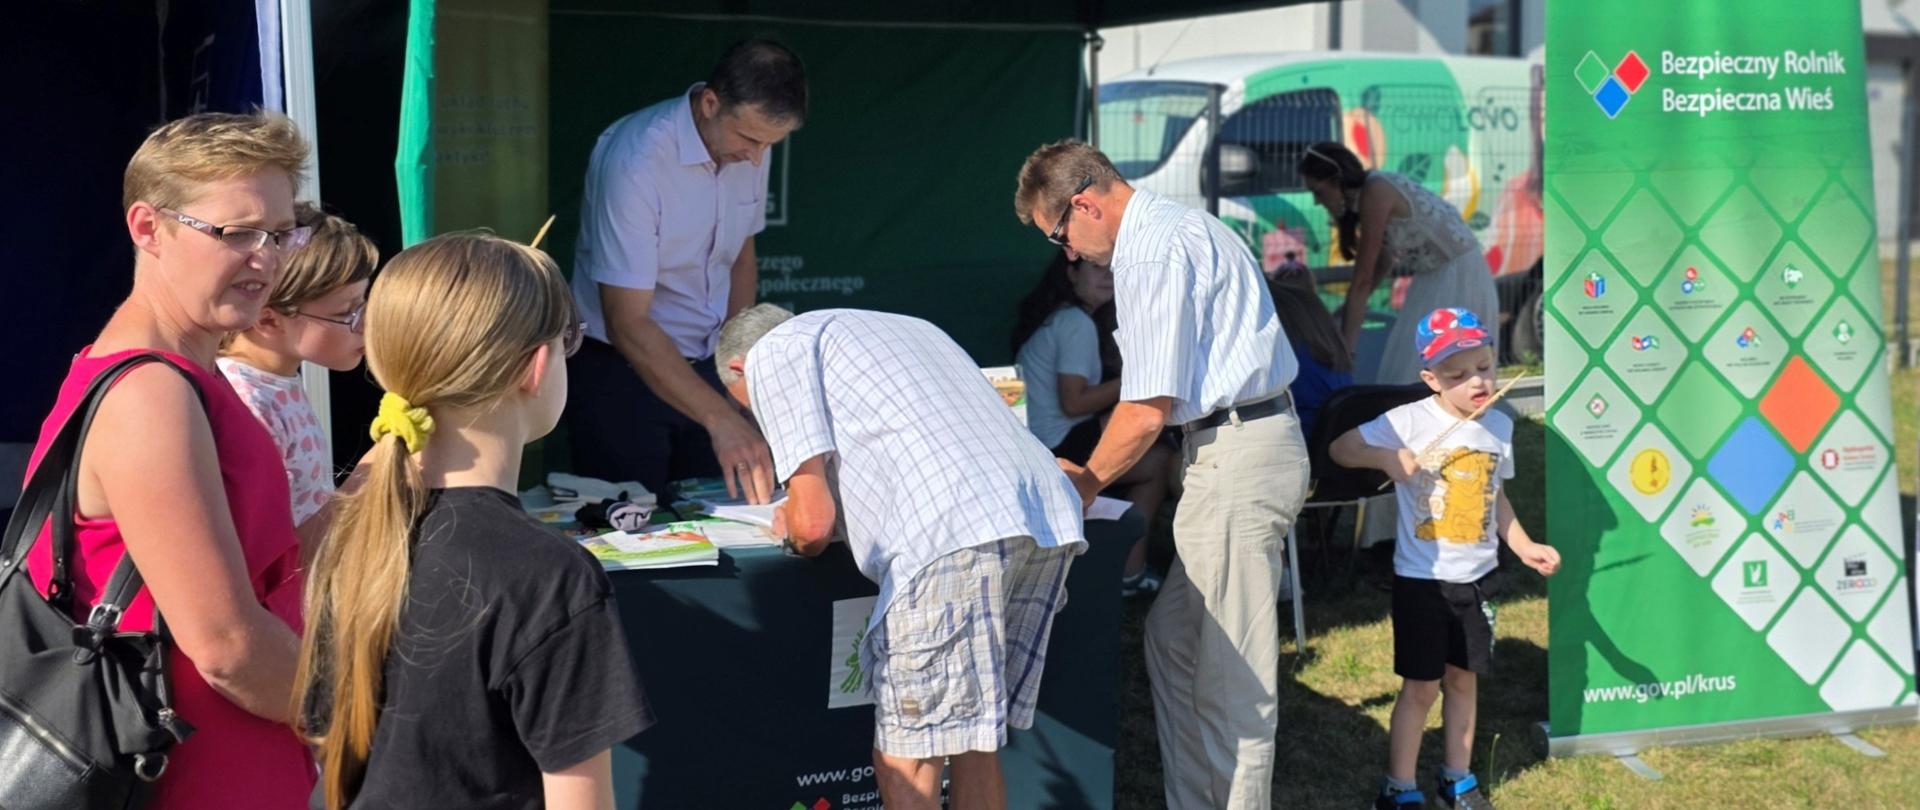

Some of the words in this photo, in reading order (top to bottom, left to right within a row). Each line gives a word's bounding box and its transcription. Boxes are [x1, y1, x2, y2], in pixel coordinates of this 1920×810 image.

[1661, 51, 1778, 79] Bezpieczny
[1786, 50, 1846, 74] Rolnik
[1661, 88, 1781, 116] Bezpieczna
[1785, 86, 1834, 111] Wieś
[1583, 673, 1736, 704] www.gov.pl/krus
